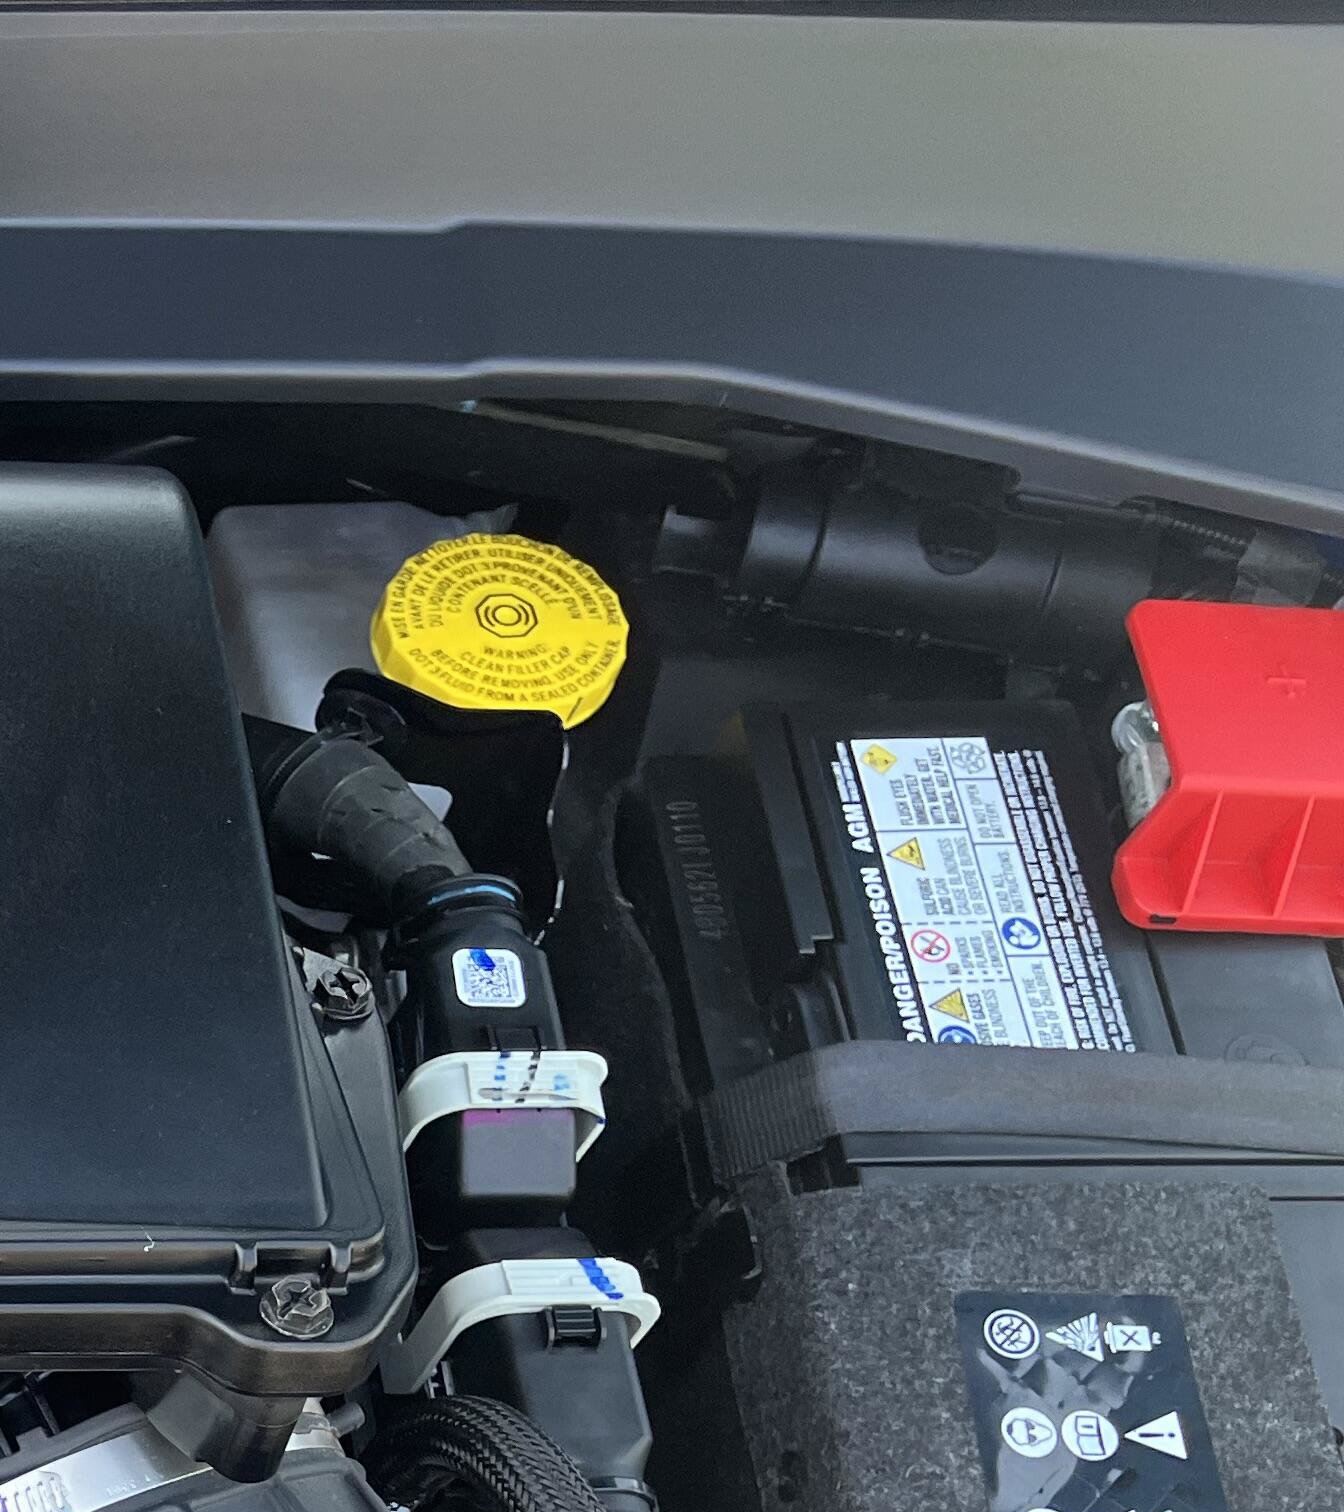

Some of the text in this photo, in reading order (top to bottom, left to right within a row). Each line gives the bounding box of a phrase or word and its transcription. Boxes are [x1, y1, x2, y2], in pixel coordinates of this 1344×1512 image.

[431, 649, 479, 680] BEFORE
[460, 651, 505, 674] CLEAN
[840, 803, 875, 852] AGM
[965, 993, 986, 1019] GASES
